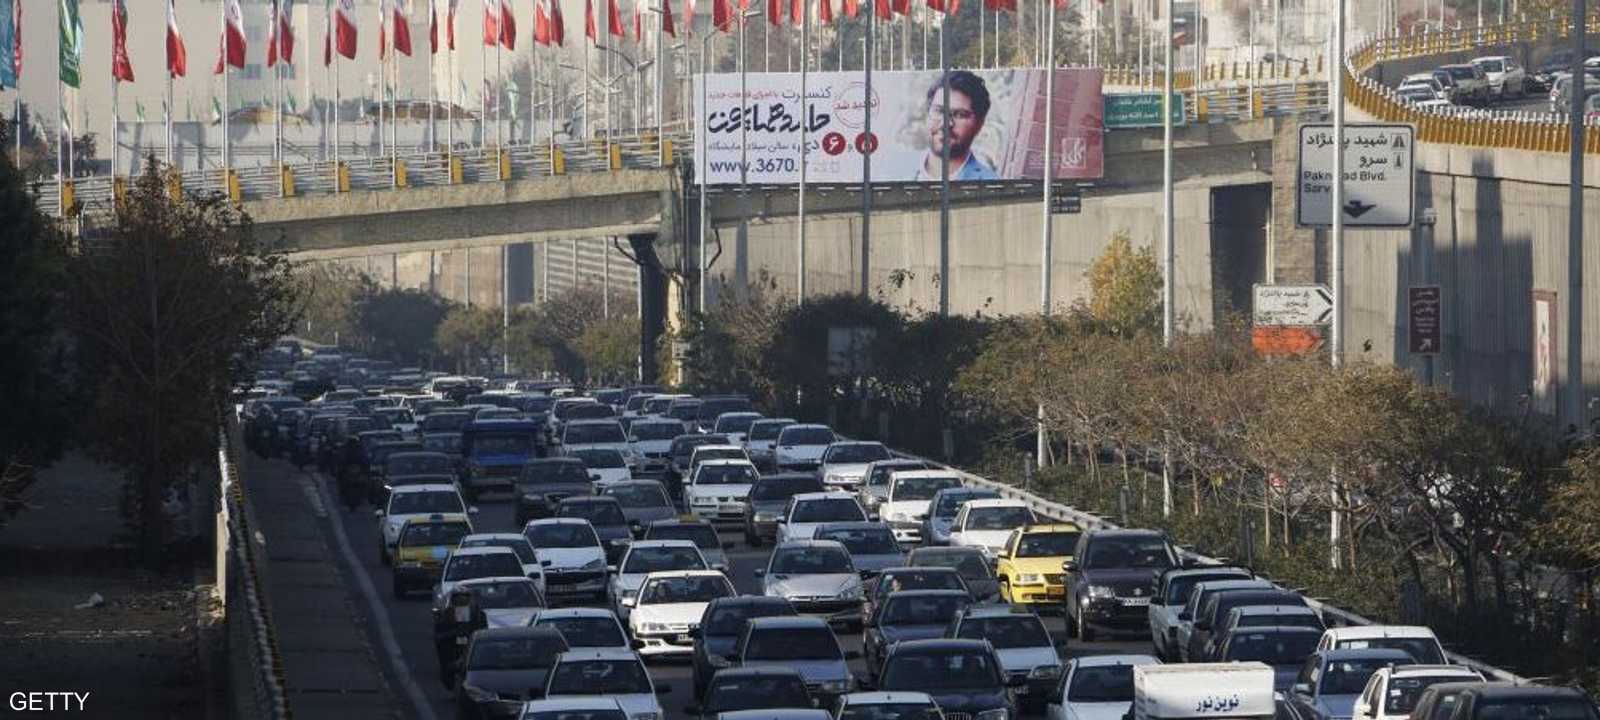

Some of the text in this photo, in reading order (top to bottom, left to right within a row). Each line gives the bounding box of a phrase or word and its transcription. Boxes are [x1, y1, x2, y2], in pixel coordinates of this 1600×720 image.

[1306, 132, 1388, 149] شهید پنژاد
[1359, 155, 1388, 168] سرو
[1303, 171, 1357, 181] Paknad
[1303, 183, 1331, 193] Sarv
[1196, 694, 1239, 712] نوین نور
